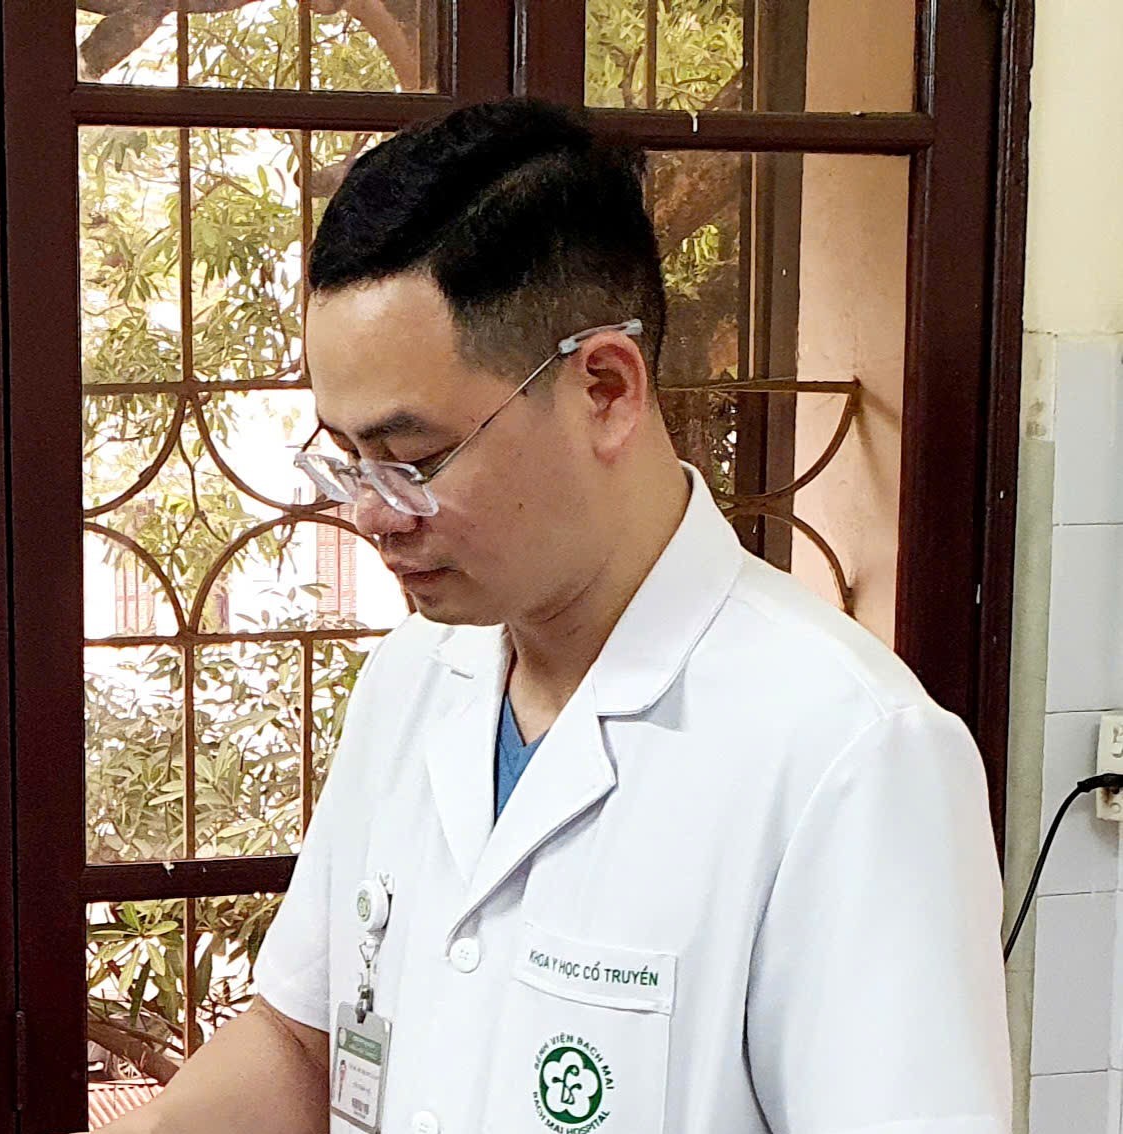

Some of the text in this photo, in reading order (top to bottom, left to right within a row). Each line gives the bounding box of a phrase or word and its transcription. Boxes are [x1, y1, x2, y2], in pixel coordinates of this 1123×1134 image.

[552, 957, 559, 973] Y
[558, 960, 581, 979] HỌC
[601, 1065, 615, 1090] MAI
[544, 1118, 565, 1134] MAI
